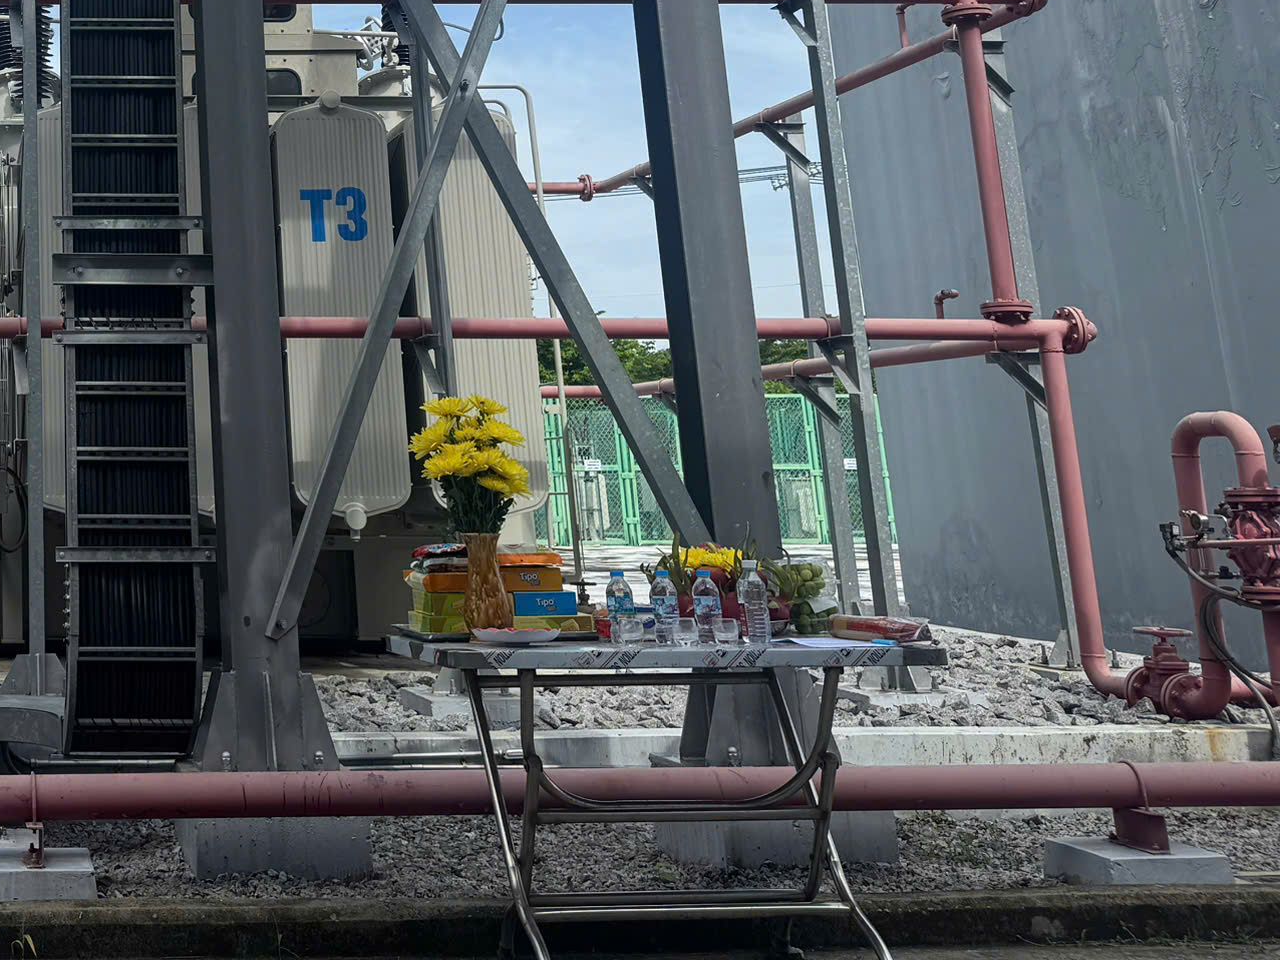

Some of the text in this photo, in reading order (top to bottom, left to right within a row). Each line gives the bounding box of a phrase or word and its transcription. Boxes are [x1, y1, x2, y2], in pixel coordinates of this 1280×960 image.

[300, 187, 368, 242] T3
[520, 572, 538, 581] Tipo
[536, 598, 554, 607] Tipo
